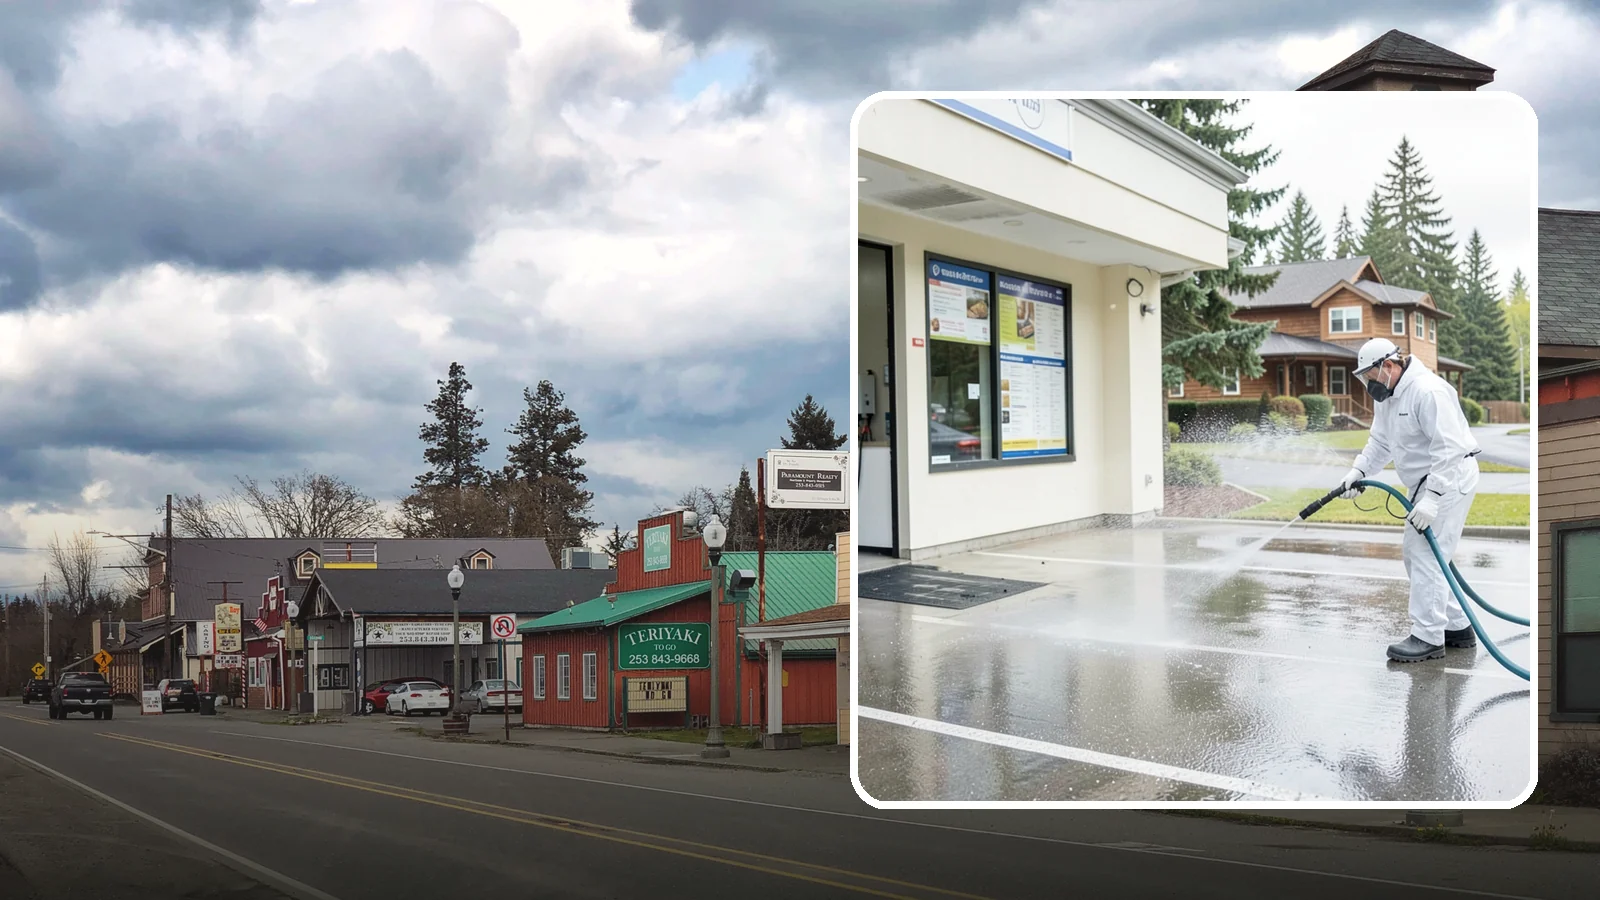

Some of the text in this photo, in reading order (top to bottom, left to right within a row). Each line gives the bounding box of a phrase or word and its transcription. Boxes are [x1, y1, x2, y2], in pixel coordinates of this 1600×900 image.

[625, 627, 702, 646] TERIYAKI
[654, 643, 676, 651] TO GO
[628, 653, 700, 665] 253 843-9668
[639, 681, 672, 691] TERIYAKI
